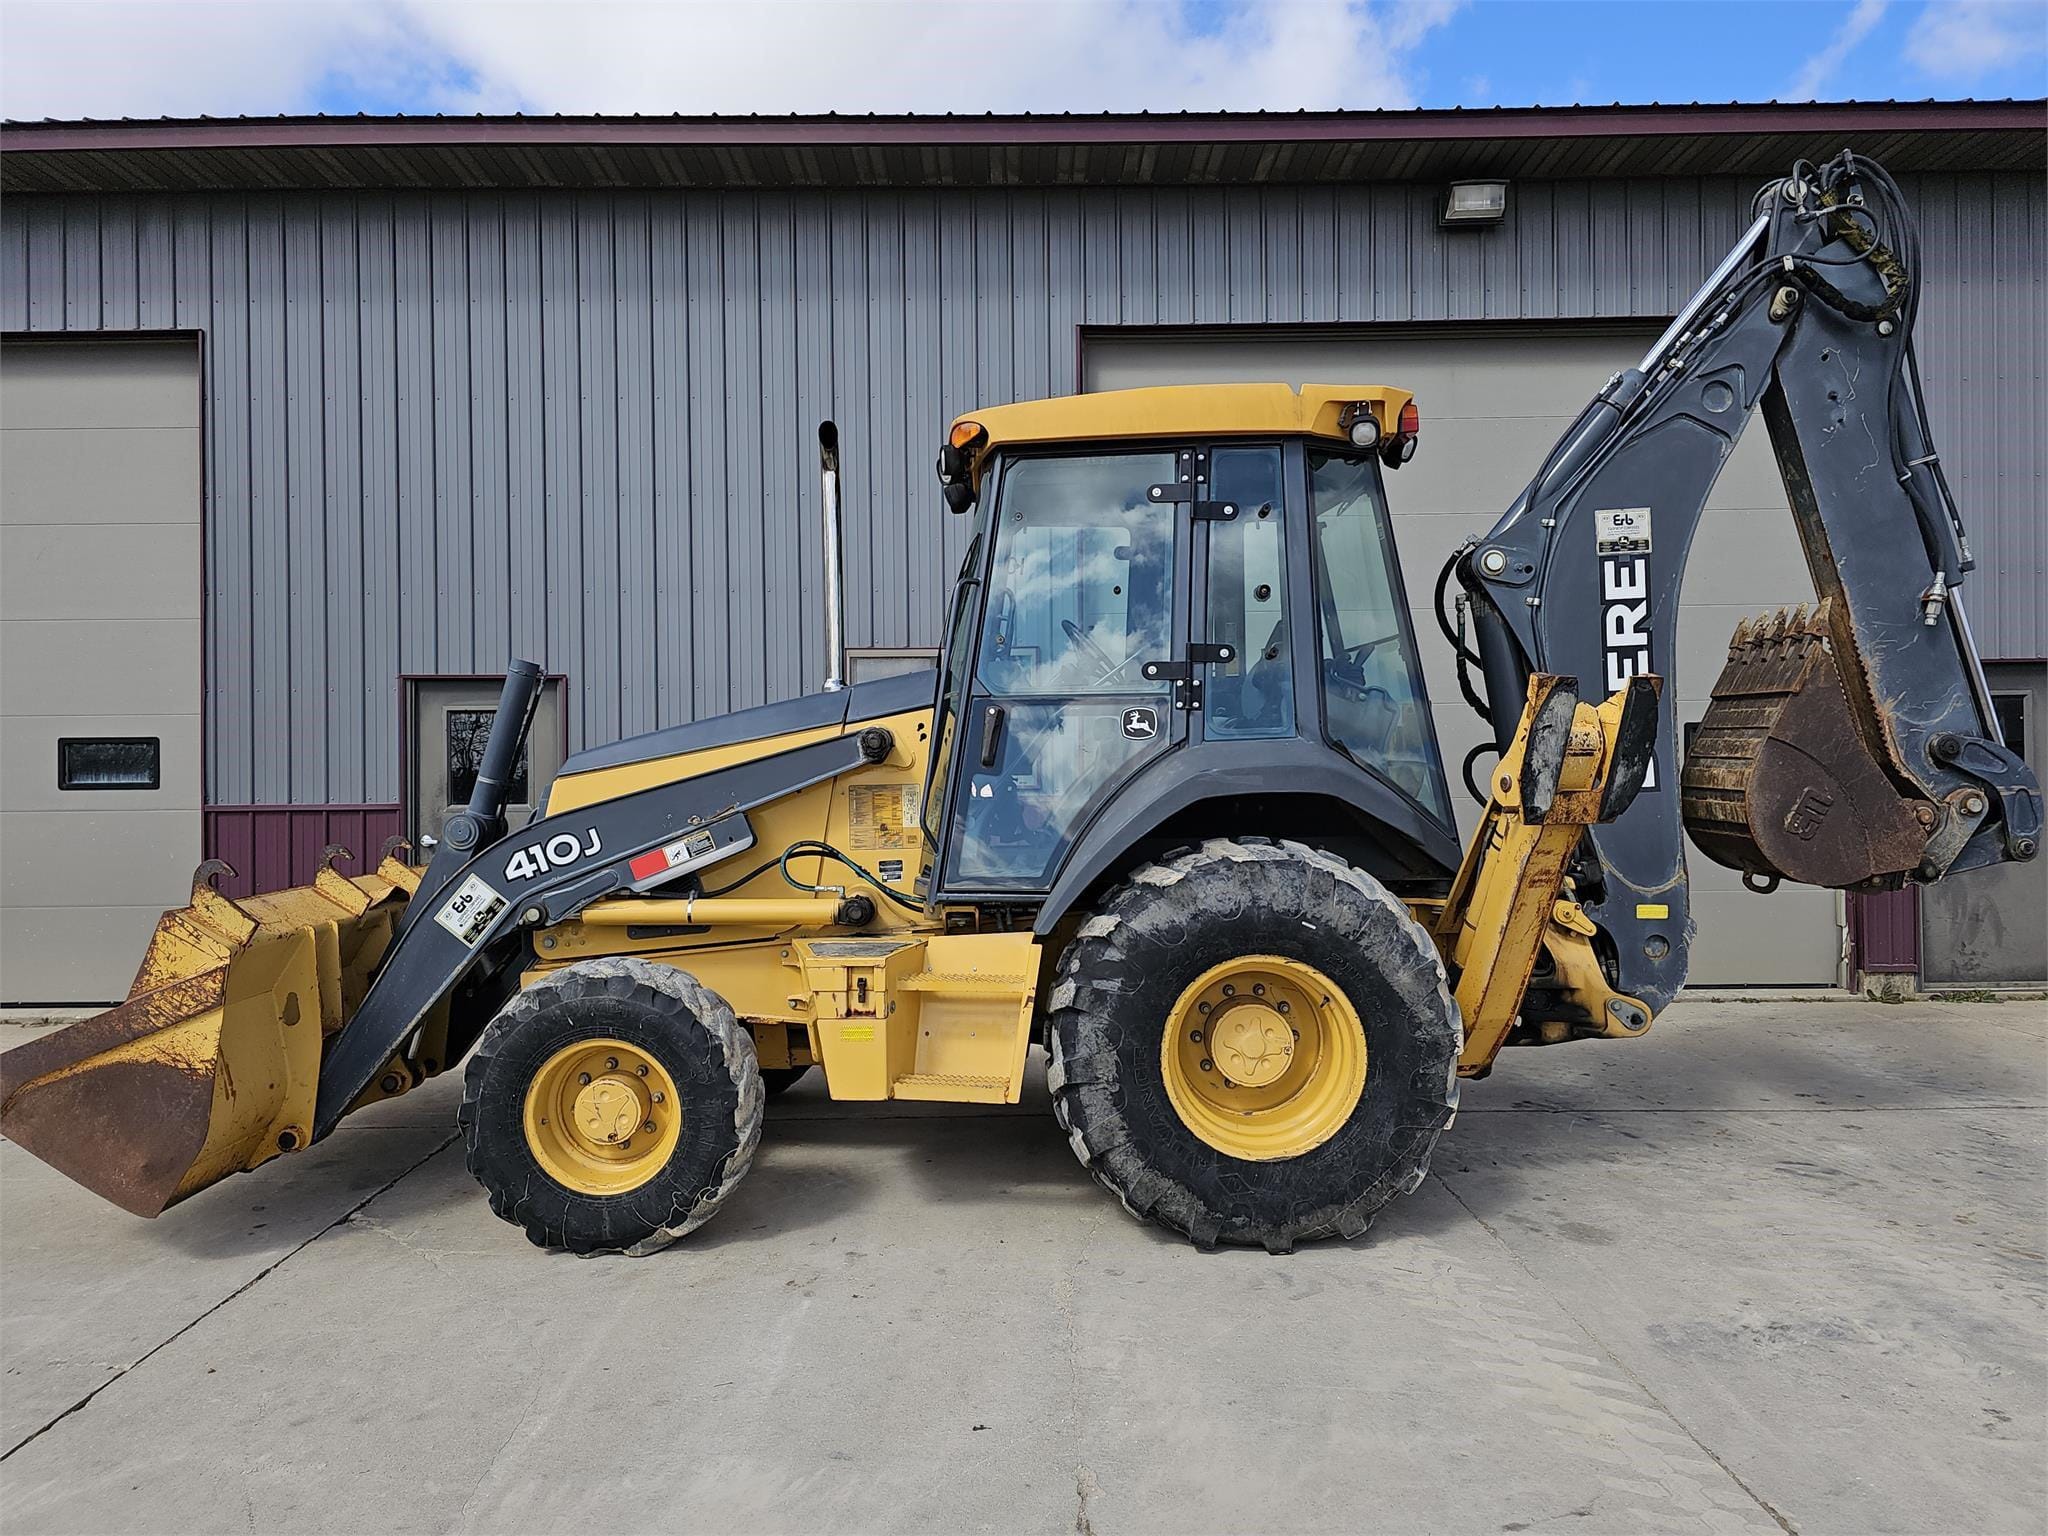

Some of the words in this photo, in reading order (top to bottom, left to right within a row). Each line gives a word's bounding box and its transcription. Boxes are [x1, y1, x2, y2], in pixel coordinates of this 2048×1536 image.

[1613, 513, 1634, 526] Erb
[1604, 559, 1656, 788] ERE
[504, 827, 602, 882] 410J
[451, 894, 474, 914] Erb
